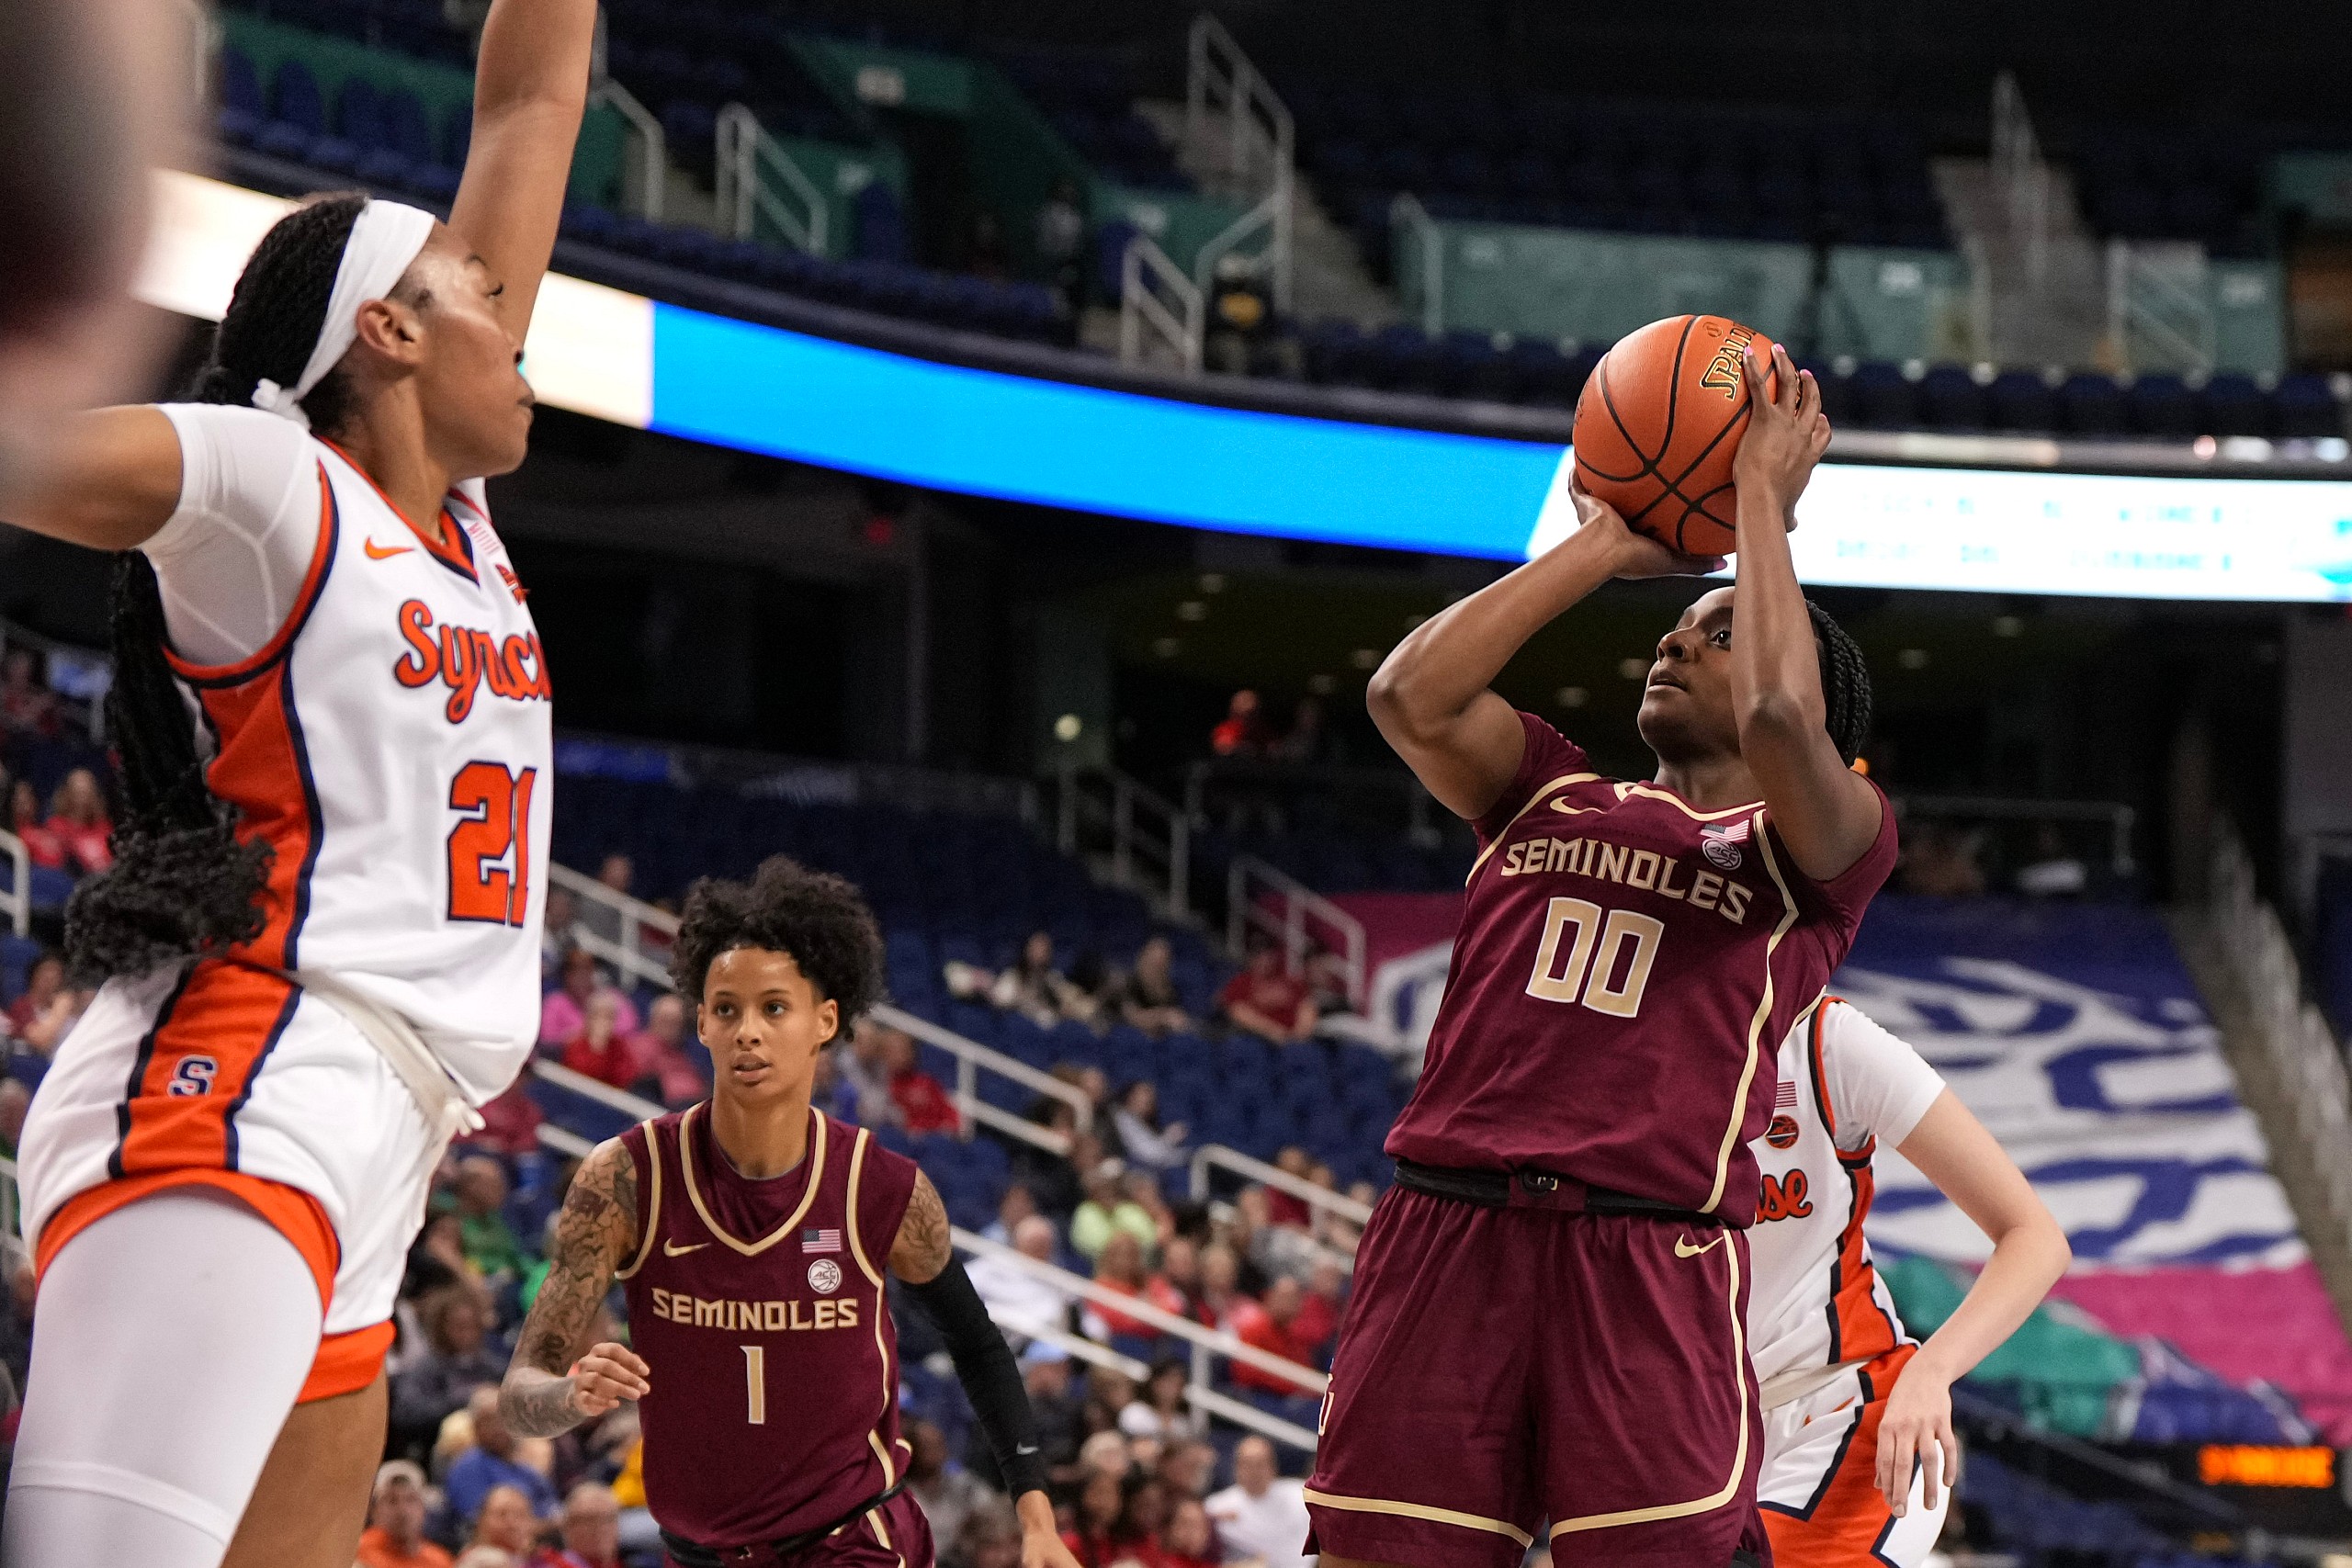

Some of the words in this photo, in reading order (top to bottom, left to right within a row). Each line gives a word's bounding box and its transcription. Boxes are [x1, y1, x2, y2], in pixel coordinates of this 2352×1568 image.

[447, 760, 537, 928] 21
[1501, 837, 1753, 924] SEMINOLES
[1525, 897, 1665, 1018] 00
[167, 1055, 218, 1099] S
[651, 1287, 858, 1331] SEMINOLES
[740, 1345, 764, 1425] 1
